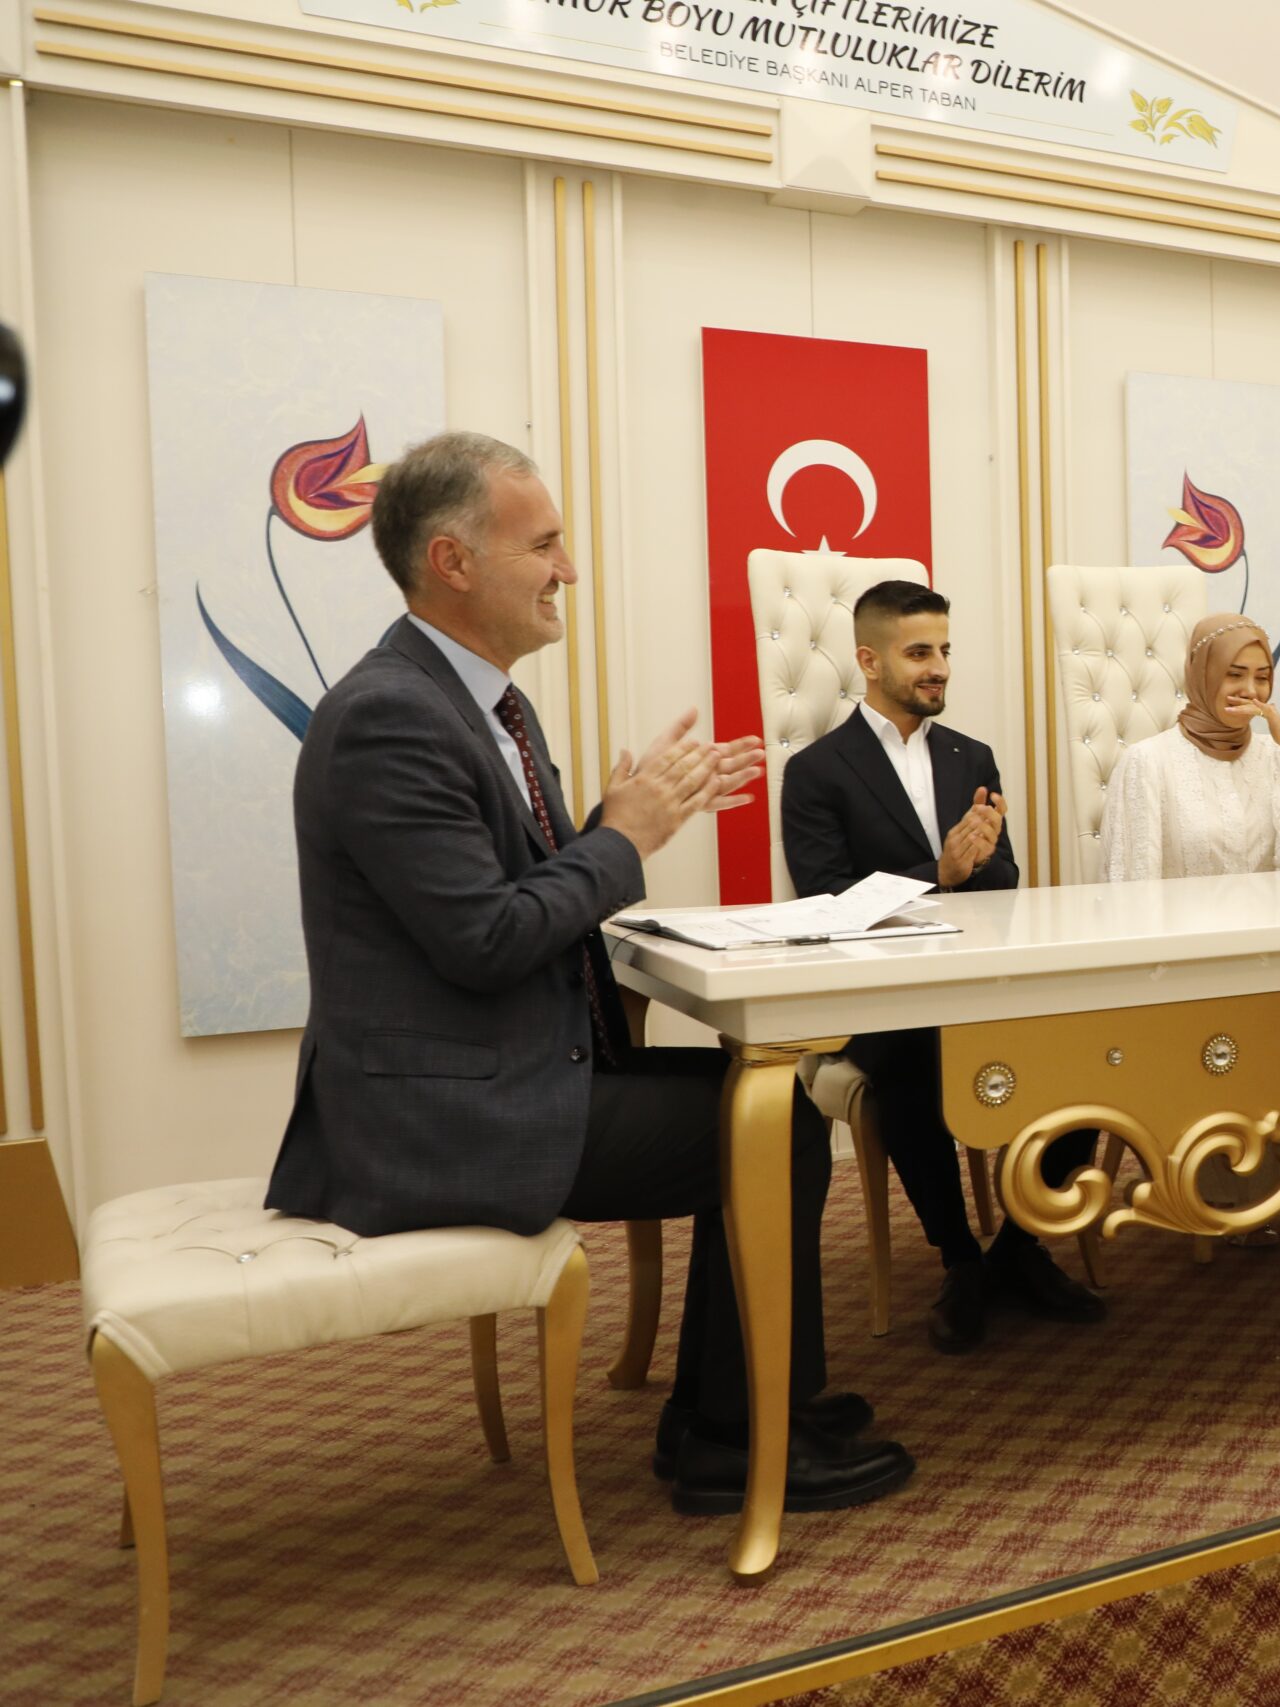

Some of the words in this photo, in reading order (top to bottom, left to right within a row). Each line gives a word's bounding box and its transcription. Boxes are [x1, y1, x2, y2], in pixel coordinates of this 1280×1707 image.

[642, 0, 734, 36] BOYU
[739, 16, 963, 80] MUTLULUKLAR
[970, 59, 1087, 103] DİLERİM
[660, 41, 760, 73] BELEDİYE
[766, 60, 849, 89] BAŞKANI
[854, 76, 913, 101] ALPER
[919, 87, 977, 112] TABAN
